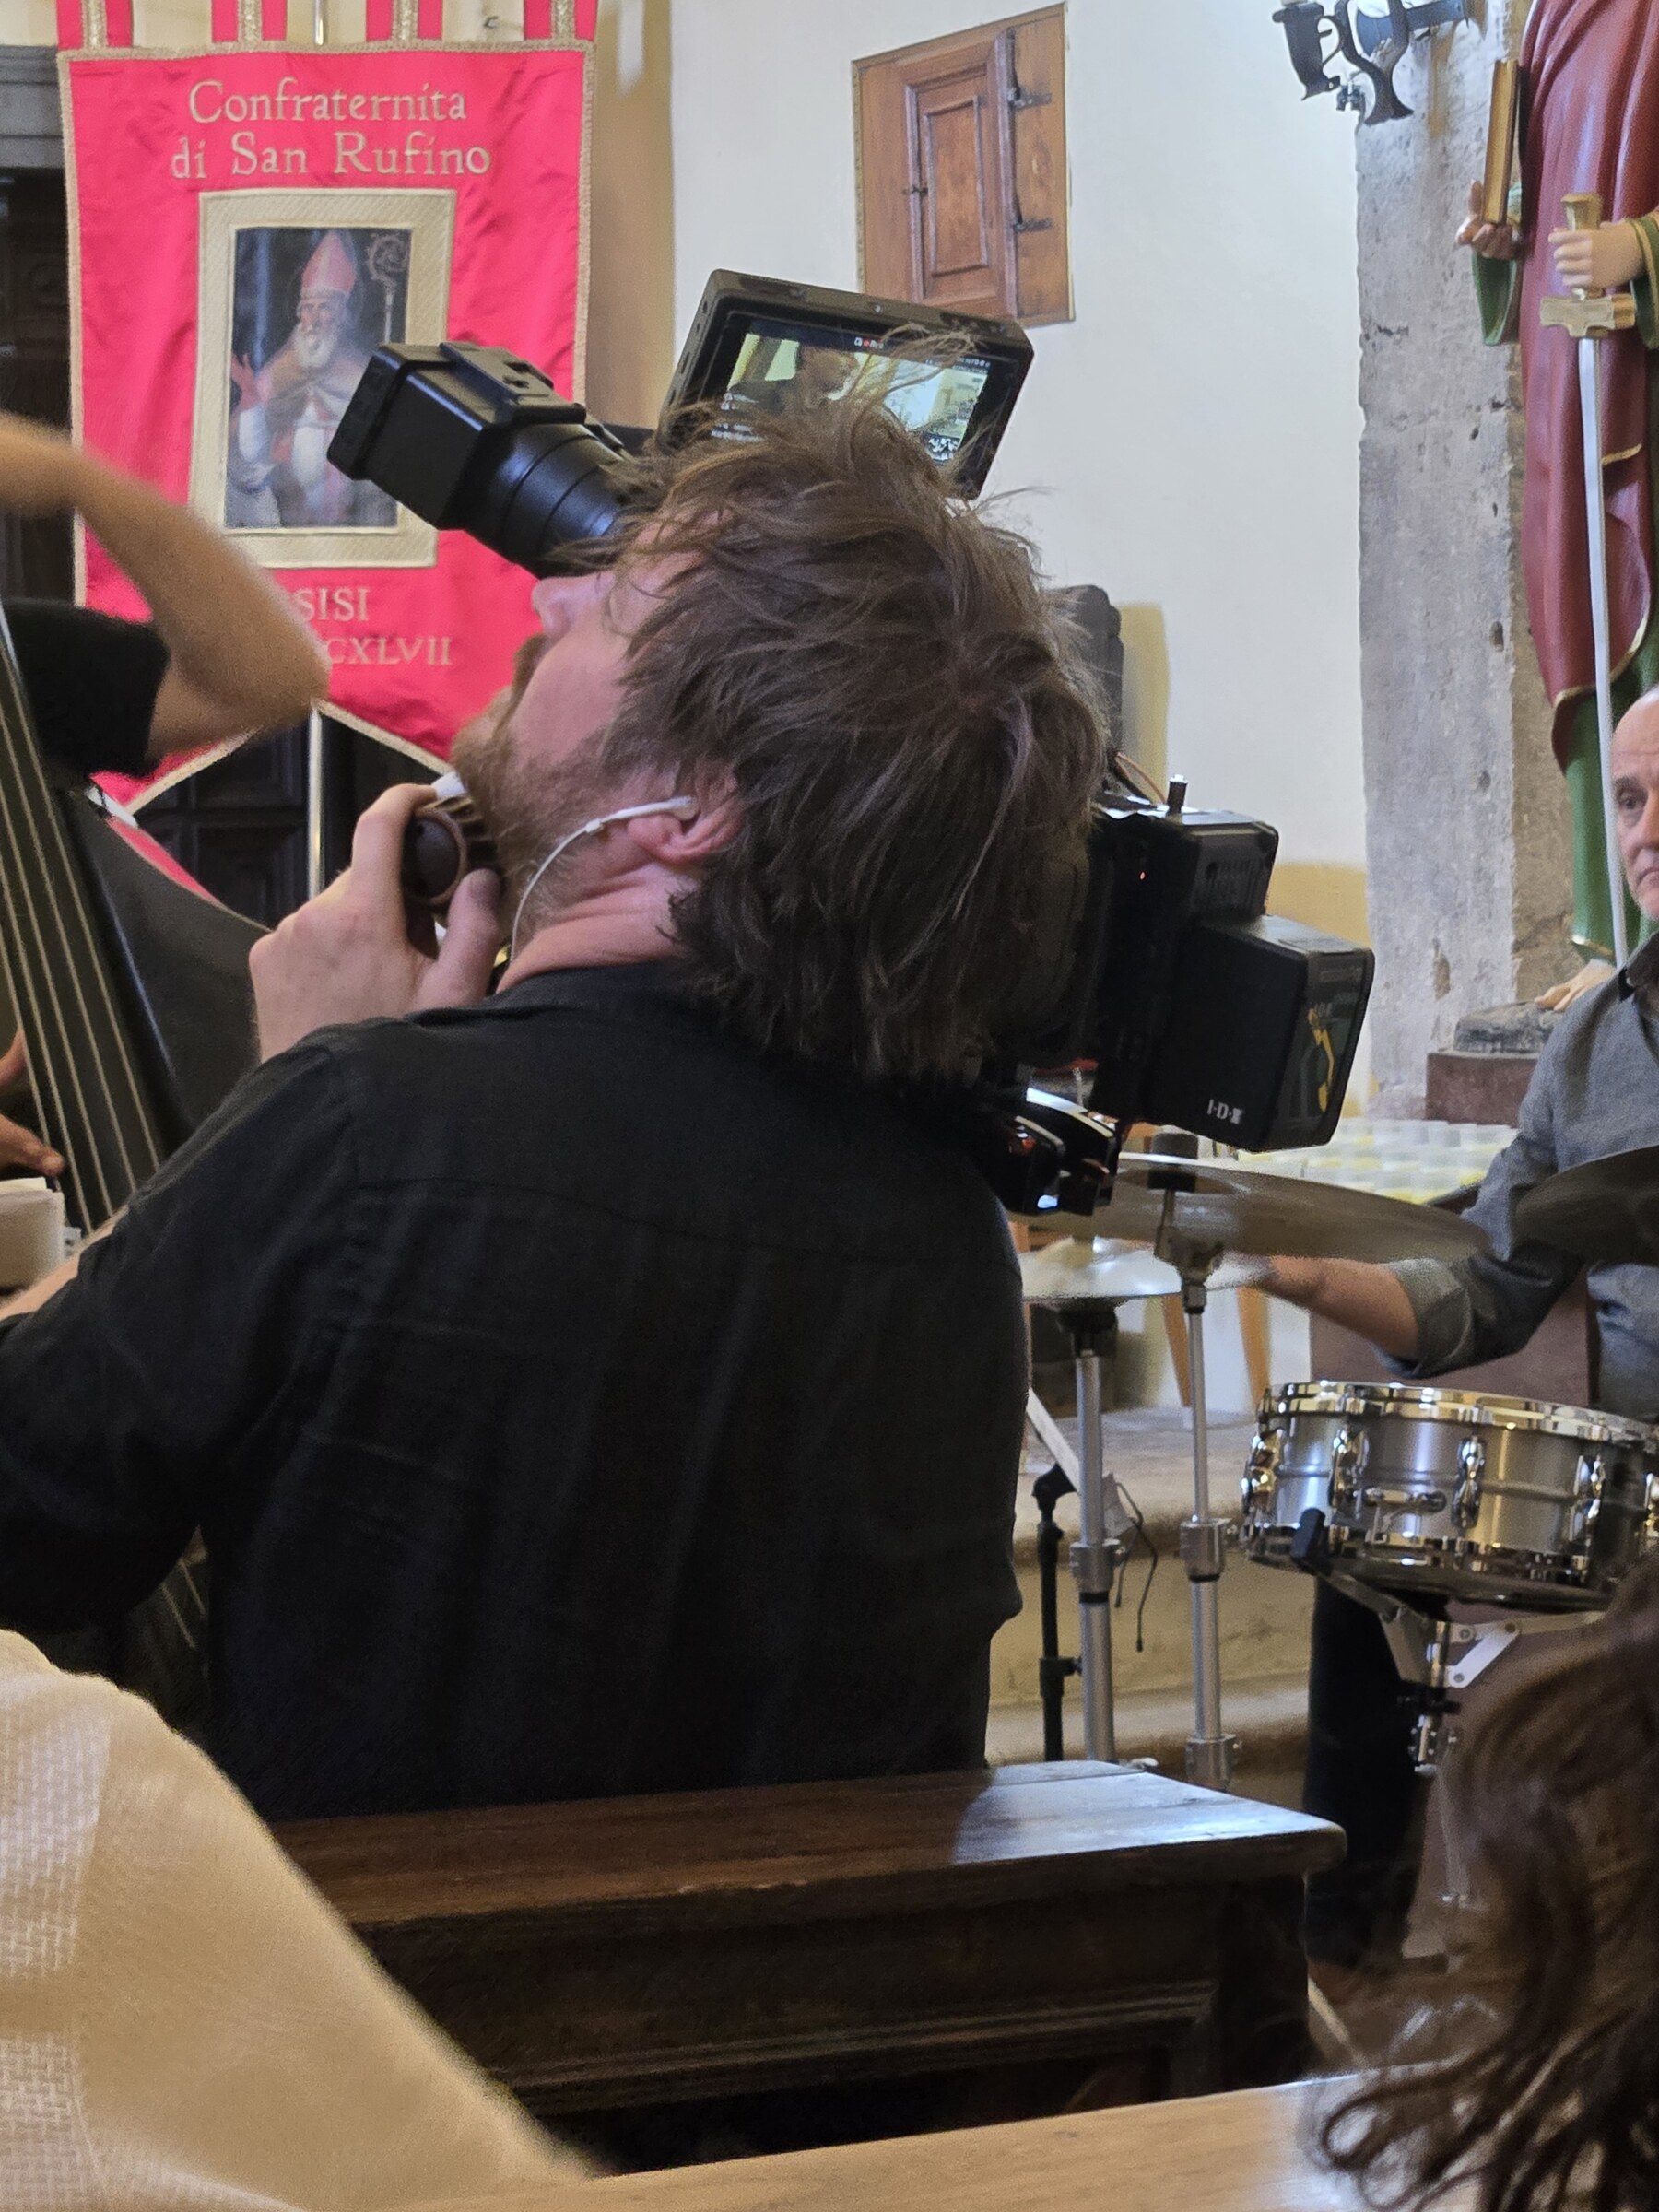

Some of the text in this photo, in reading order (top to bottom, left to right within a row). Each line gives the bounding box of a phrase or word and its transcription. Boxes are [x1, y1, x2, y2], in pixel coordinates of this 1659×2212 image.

[188, 77, 466, 124] Confraternita
[171, 130, 491, 179] di San Rufino
[294, 587, 371, 622] SISI
[324, 636, 452, 665] CXLVII
